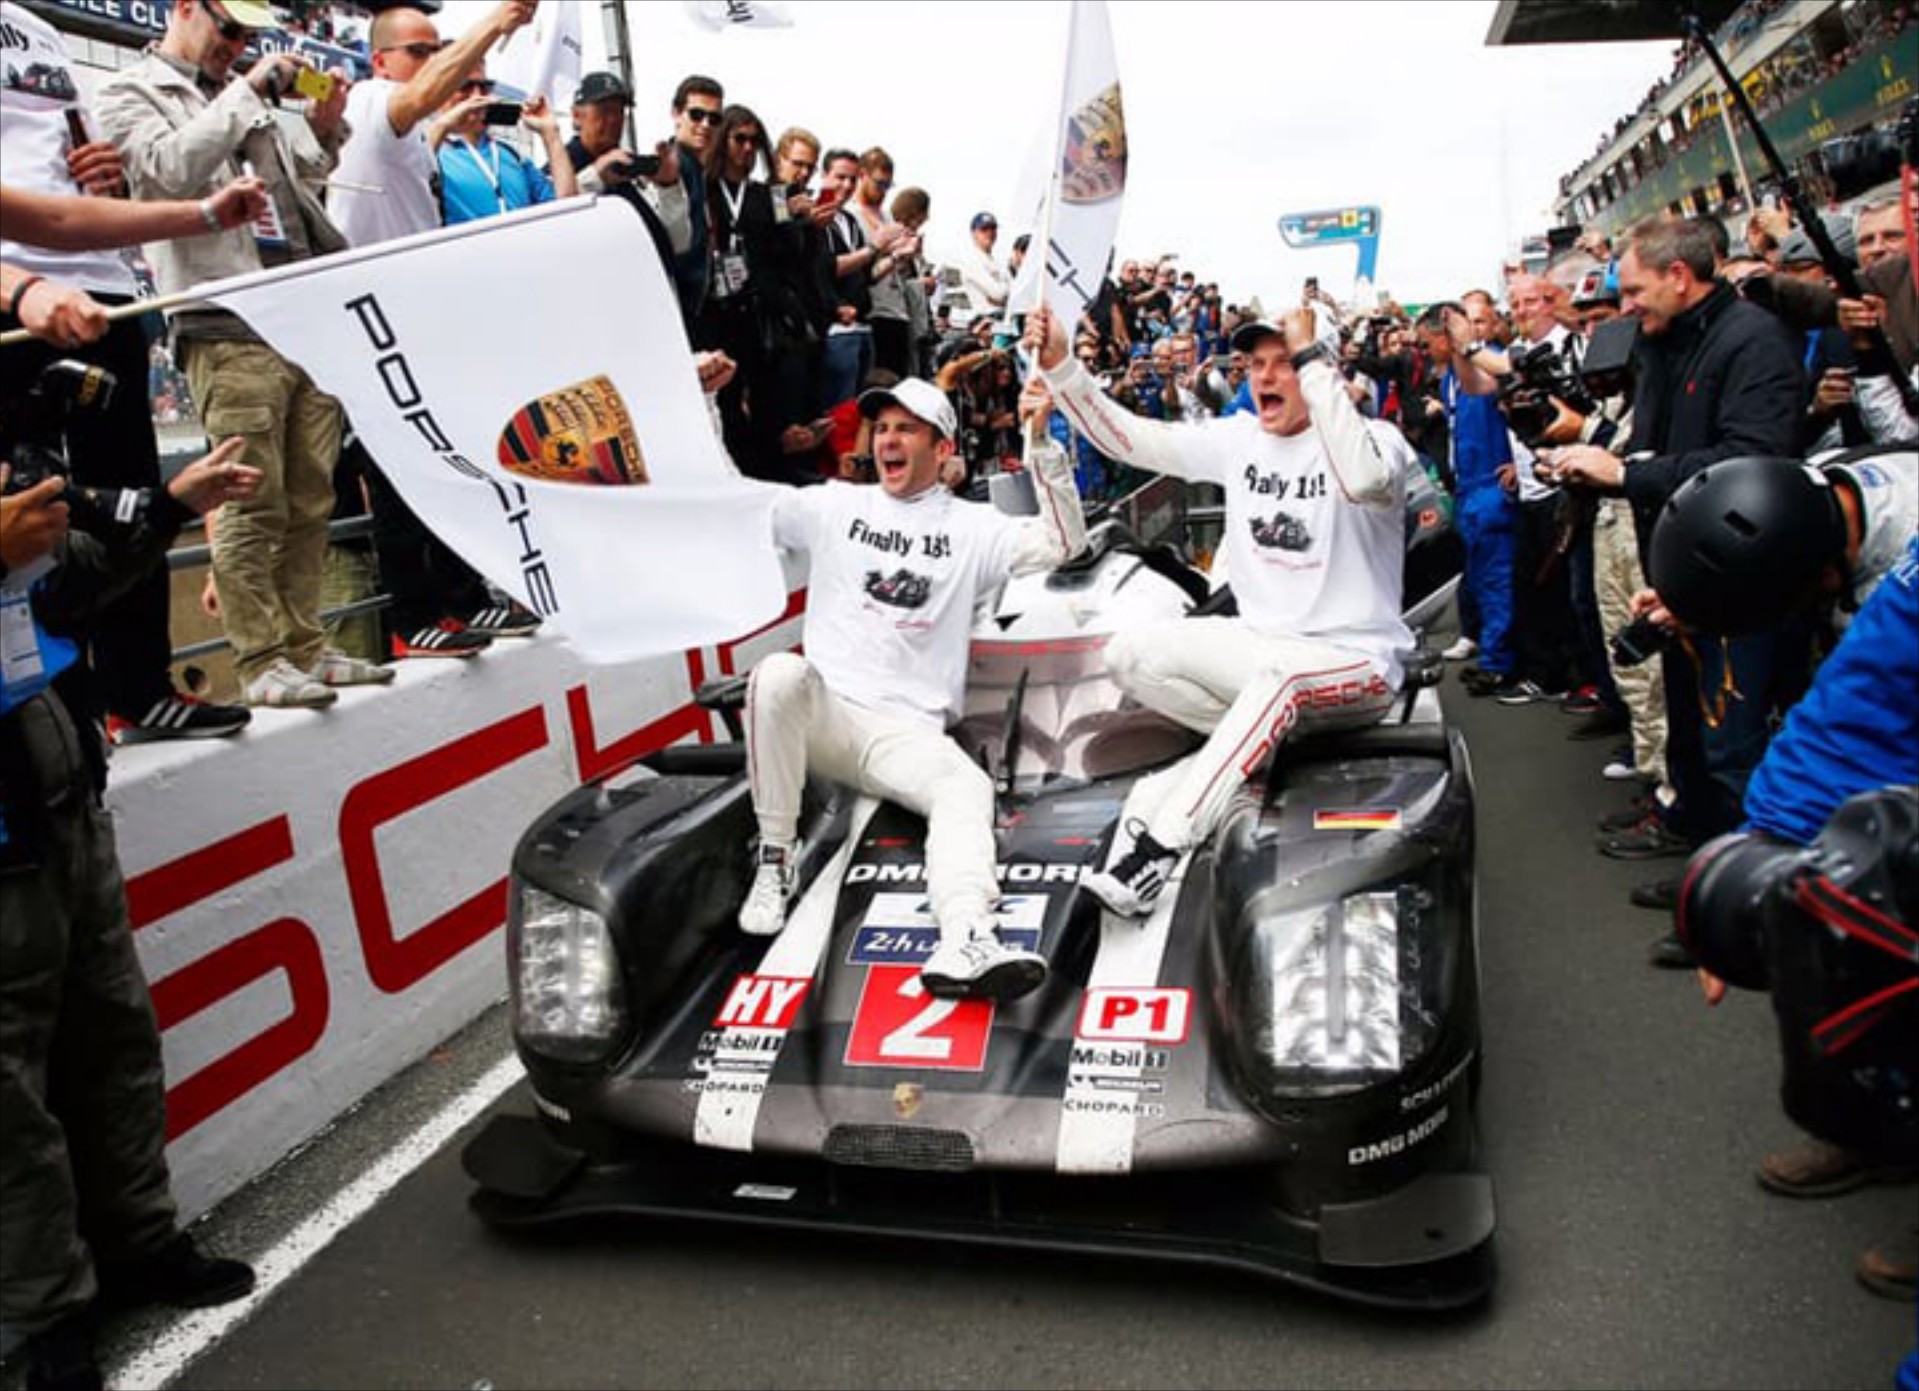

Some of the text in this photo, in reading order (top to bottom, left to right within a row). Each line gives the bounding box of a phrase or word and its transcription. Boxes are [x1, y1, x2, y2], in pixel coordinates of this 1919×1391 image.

[848, 519, 914, 557] Finally
[845, 863, 928, 885] DM
[718, 975, 809, 1023] HY
[879, 972, 960, 1059] 2
[1098, 995, 1170, 1033] P1
[1072, 1048, 1142, 1067] Mobil
[1348, 1134, 1405, 1165] DMG
